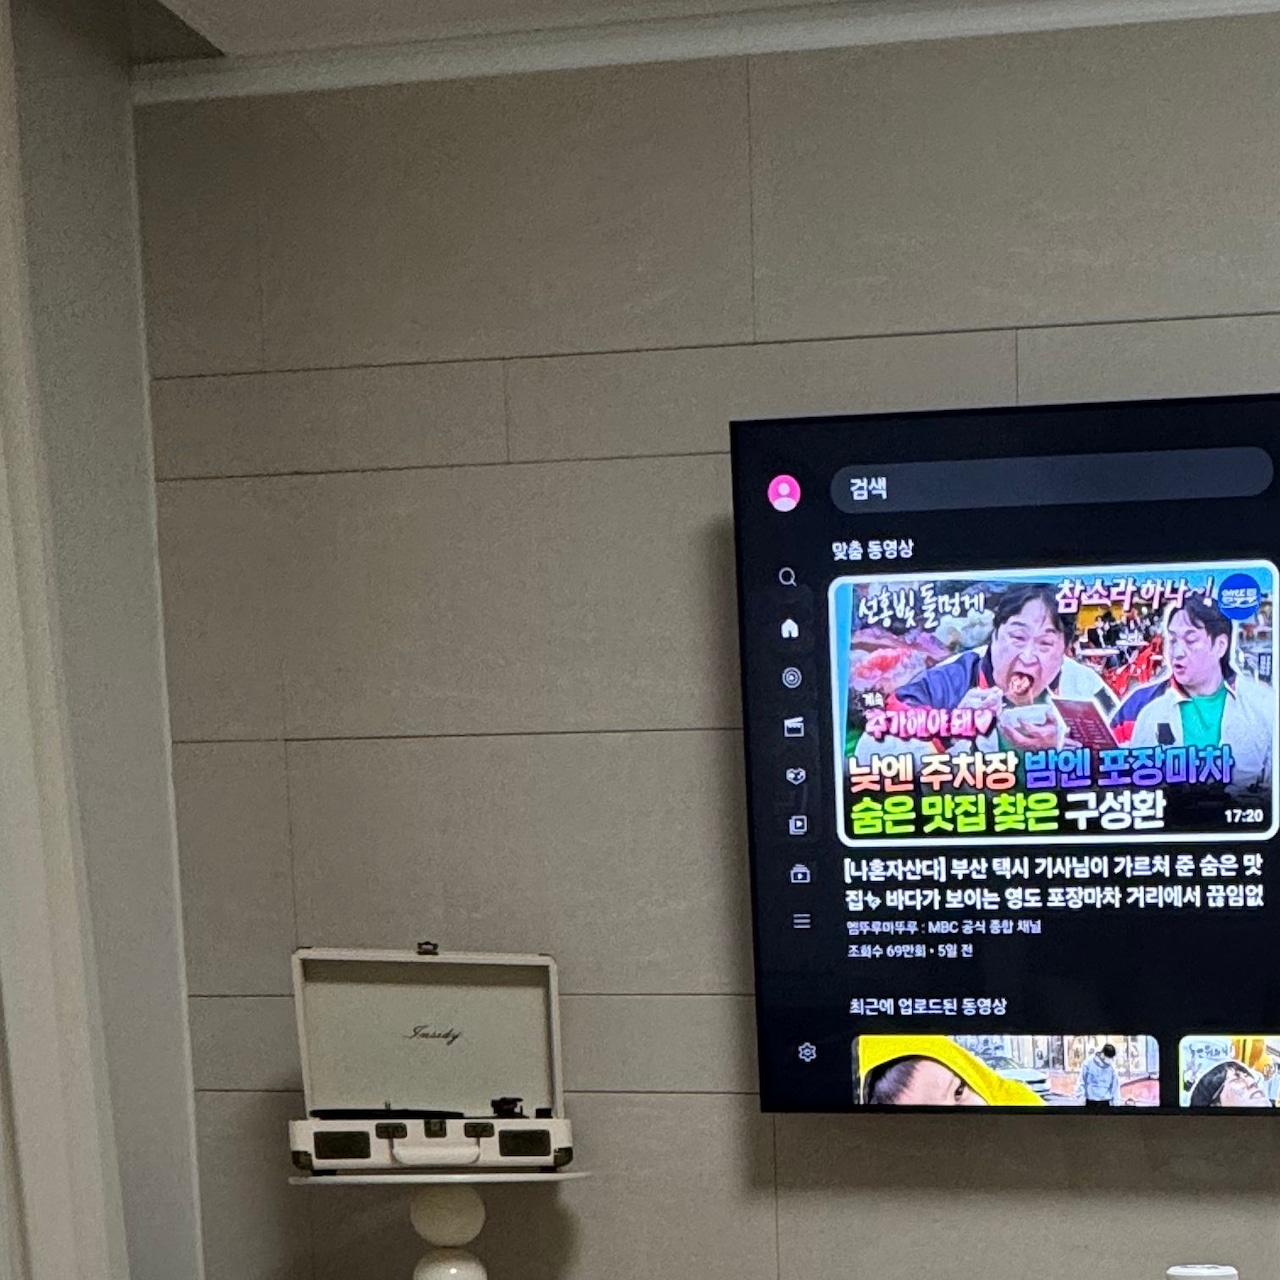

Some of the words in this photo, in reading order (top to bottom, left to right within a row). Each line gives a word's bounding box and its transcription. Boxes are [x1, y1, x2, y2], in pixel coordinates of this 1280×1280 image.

[851, 477, 887, 500] 검색
[832, 540, 863, 561] 맞춤
[867, 539, 914, 560] 동영상
[848, 753, 914, 793] 낮엔
[919, 752, 1017, 790] 주차장
[1025, 749, 1091, 788] 밤엔
[1098, 745, 1233, 786] 포장마차
[851, 794, 916, 835] 숨은
[922, 793, 986, 833] 맛집
[993, 793, 1059, 832] 찾은
[1064, 790, 1166, 831] 구성환
[1225, 809, 1263, 822] 17:20
[844, 856, 946, 884] [나혼자산다]
[951, 858, 988, 880] 부산
[992, 856, 1029, 879] 택시
[1035, 856, 1108, 879] 기사님이
[1175, 855, 1195, 876] 준
[1199, 854, 1238, 876] 숨은
[1243, 853, 1263, 876] 맛
[886, 889, 941, 910] 바다가
[945, 888, 1000, 910] 보이는
[1005, 888, 1042, 909] 영도
[1047, 887, 1122, 908] 포장마차
[1126, 885, 1200, 908] 거리에서
[1206, 884, 1264, 907] 끊임없
[928, 921, 959, 933] MBC
[962, 920, 985, 934] 공식
[989, 919, 1014, 934] 종합
[1017, 920, 1041, 933] 채널
[848, 945, 883, 958] 조회수
[886, 944, 926, 958] 69만회
[938, 943, 957, 958] 5일
[961, 944, 973, 957] 전
[850, 998, 894, 1015] 최근에
[898, 998, 957, 1015] 업로드된
[962, 998, 1007, 1015] 동영상
